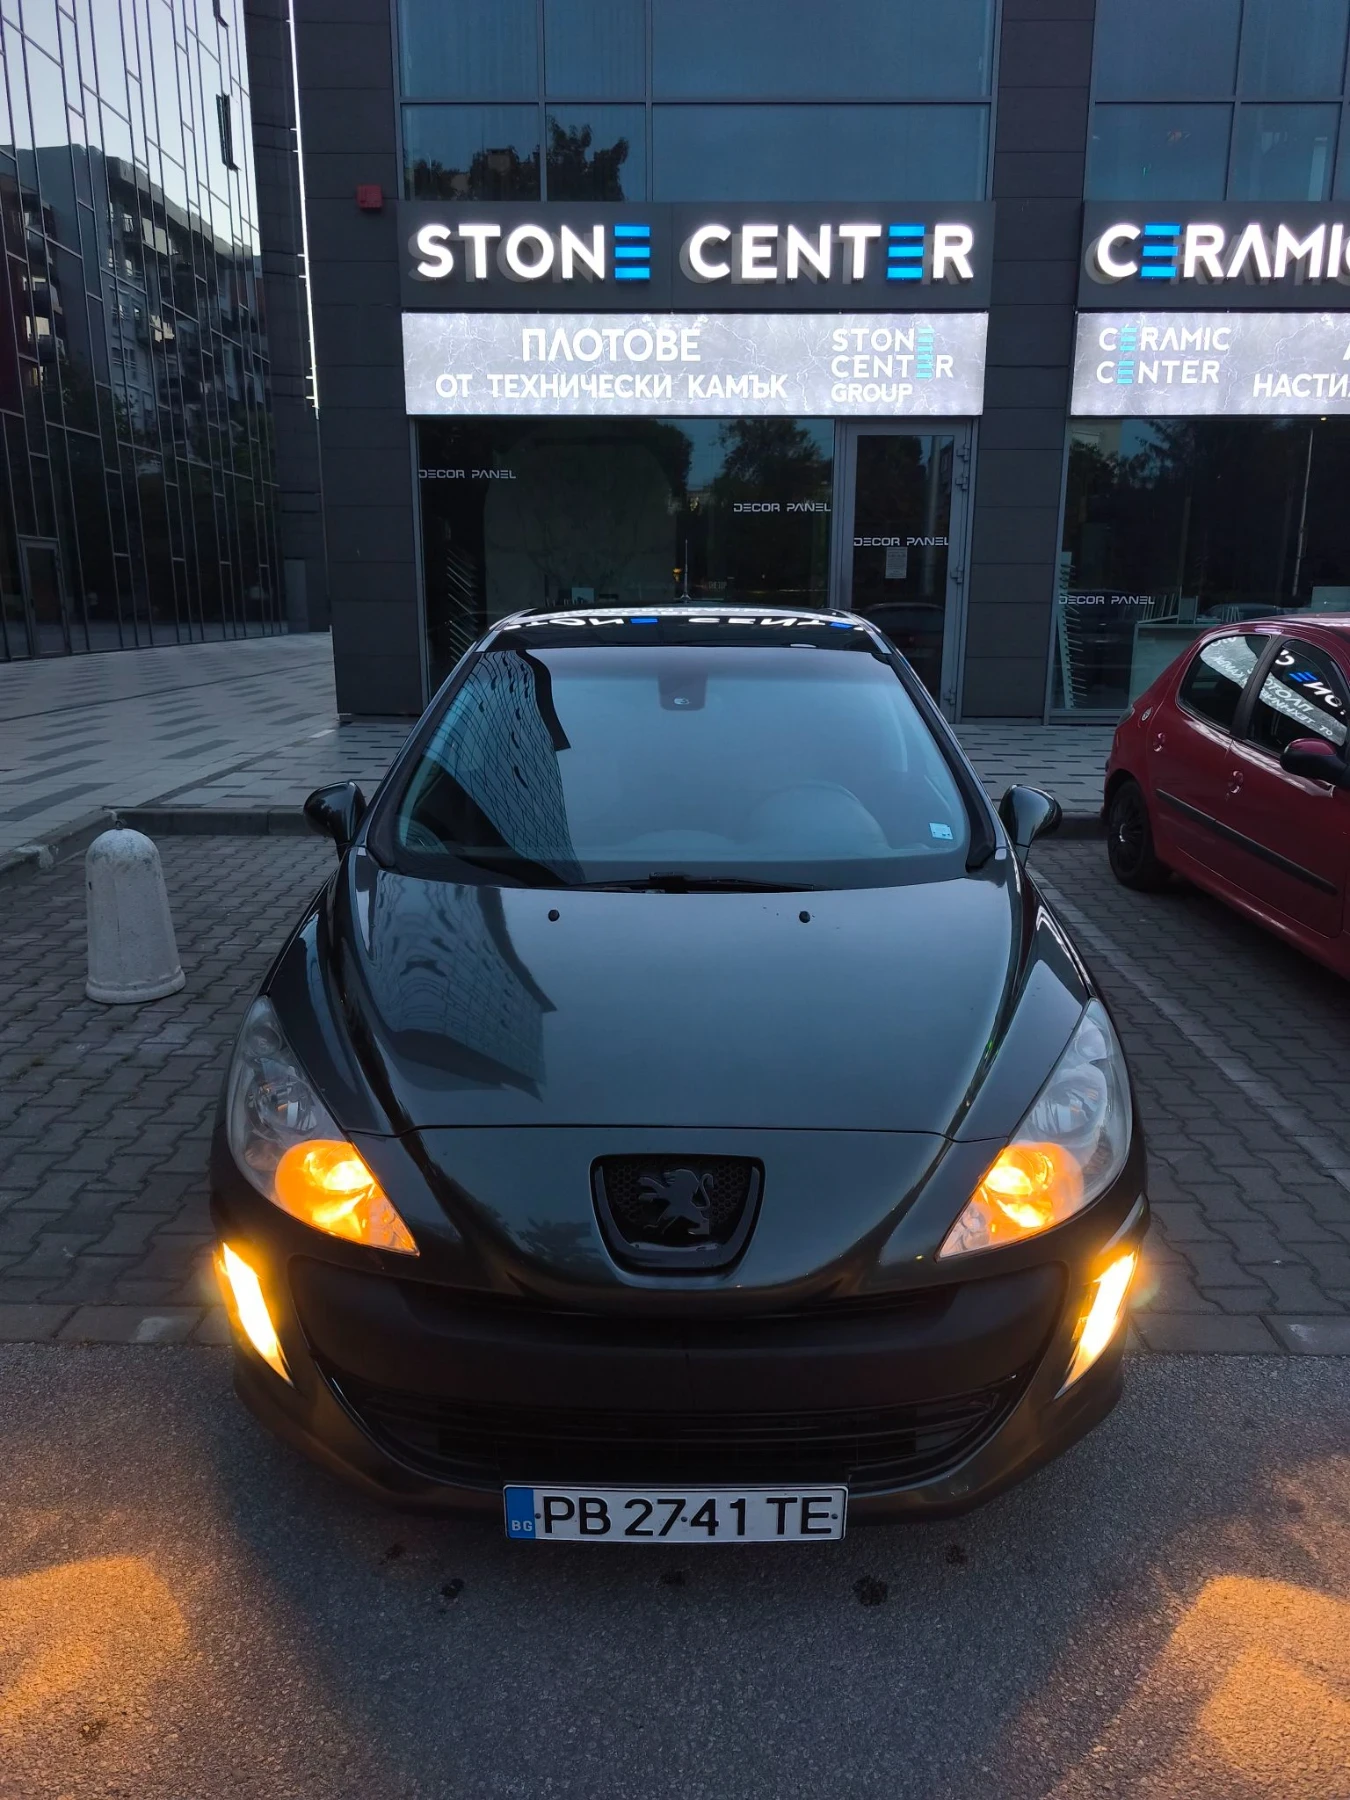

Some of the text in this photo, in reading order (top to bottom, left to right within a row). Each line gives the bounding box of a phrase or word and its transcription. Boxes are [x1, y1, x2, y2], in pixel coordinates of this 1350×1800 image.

[416, 224, 974, 280] STONE CENTER
[522, 328, 702, 363] ПЛОТОВЕ
[832, 327, 936, 353] STONE
[1098, 327, 1232, 352] CERAMIC
[831, 353, 955, 380] CENTER
[1096, 360, 1220, 385] CENTER
[435, 373, 789, 400] ОТ ТЕХНИЧЕСКИ КАМЪК
[830, 384, 914, 404] GROUP
[1252, 373, 1350, 398] НАСТИ
[418, 468, 517, 480] DECOR PANEL
[733, 502, 832, 514] DECOR PANEL
[853, 536, 949, 547] DECOR PANEL
[1058, 595, 1156, 606] DECOR PANEL
[511, 1495, 833, 1537] BG PB 2741 TE
